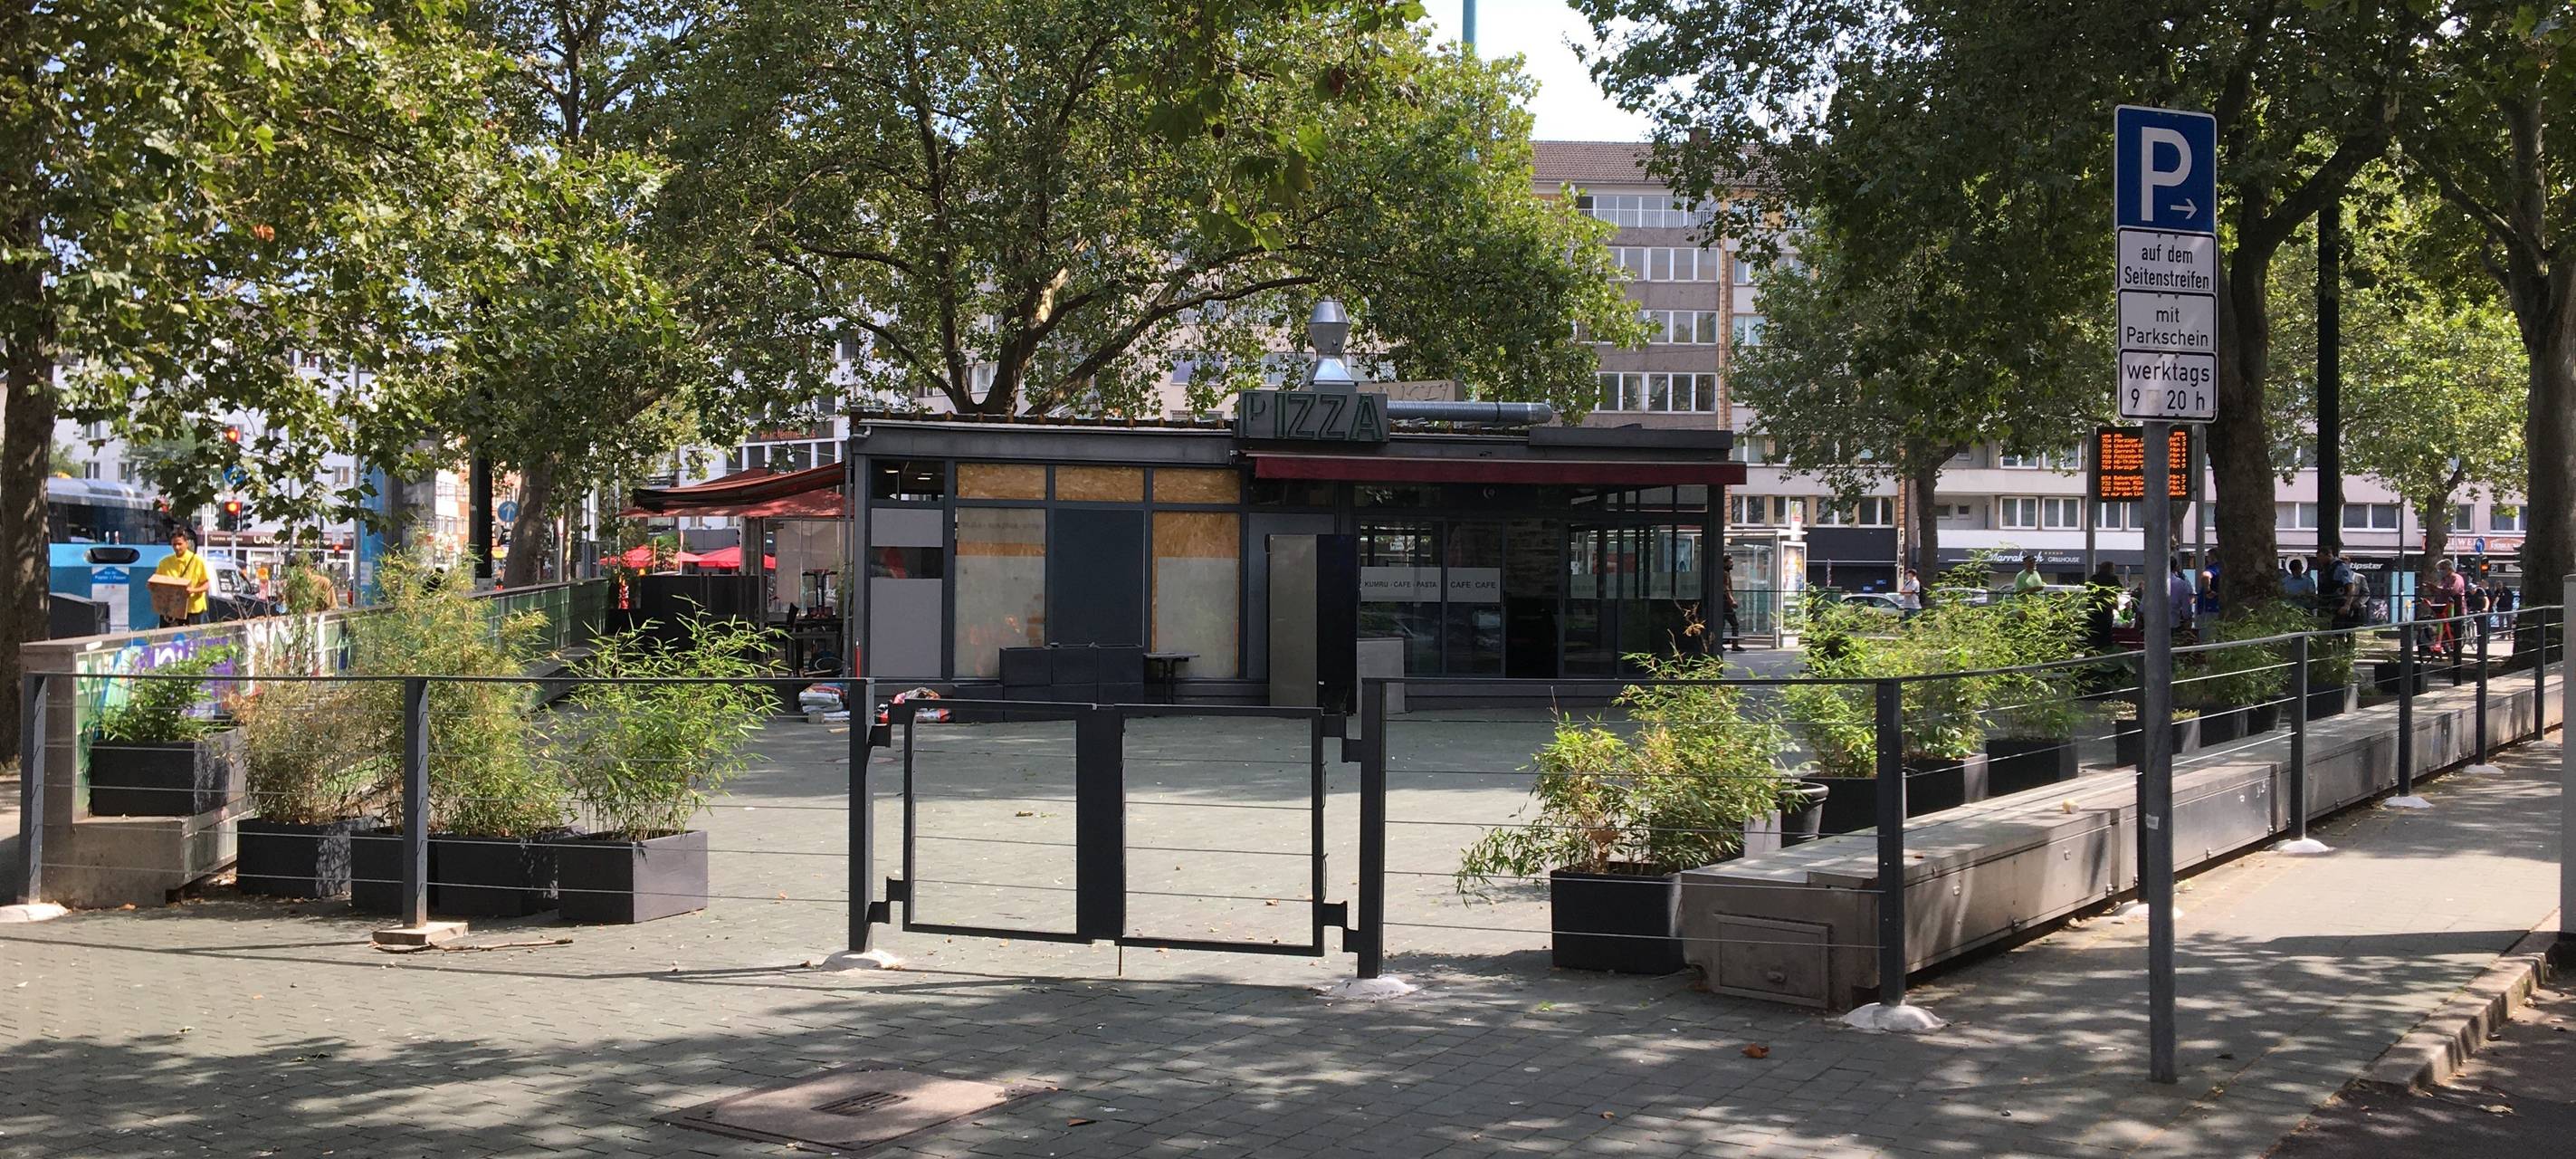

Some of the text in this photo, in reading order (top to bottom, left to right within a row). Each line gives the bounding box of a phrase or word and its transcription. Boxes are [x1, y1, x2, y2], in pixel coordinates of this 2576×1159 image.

[2142, 126, 2192, 222] P
[2142, 244, 2193, 264] auf dem
[2124, 266, 2209, 290] Seitenstreifen
[2156, 307, 2180, 323] mit
[2127, 326, 2209, 347] Parkschein
[2127, 361, 2209, 388] werktags
[2132, 388, 2205, 411] 9 20 h
[1245, 392, 1384, 441] PIZZA
